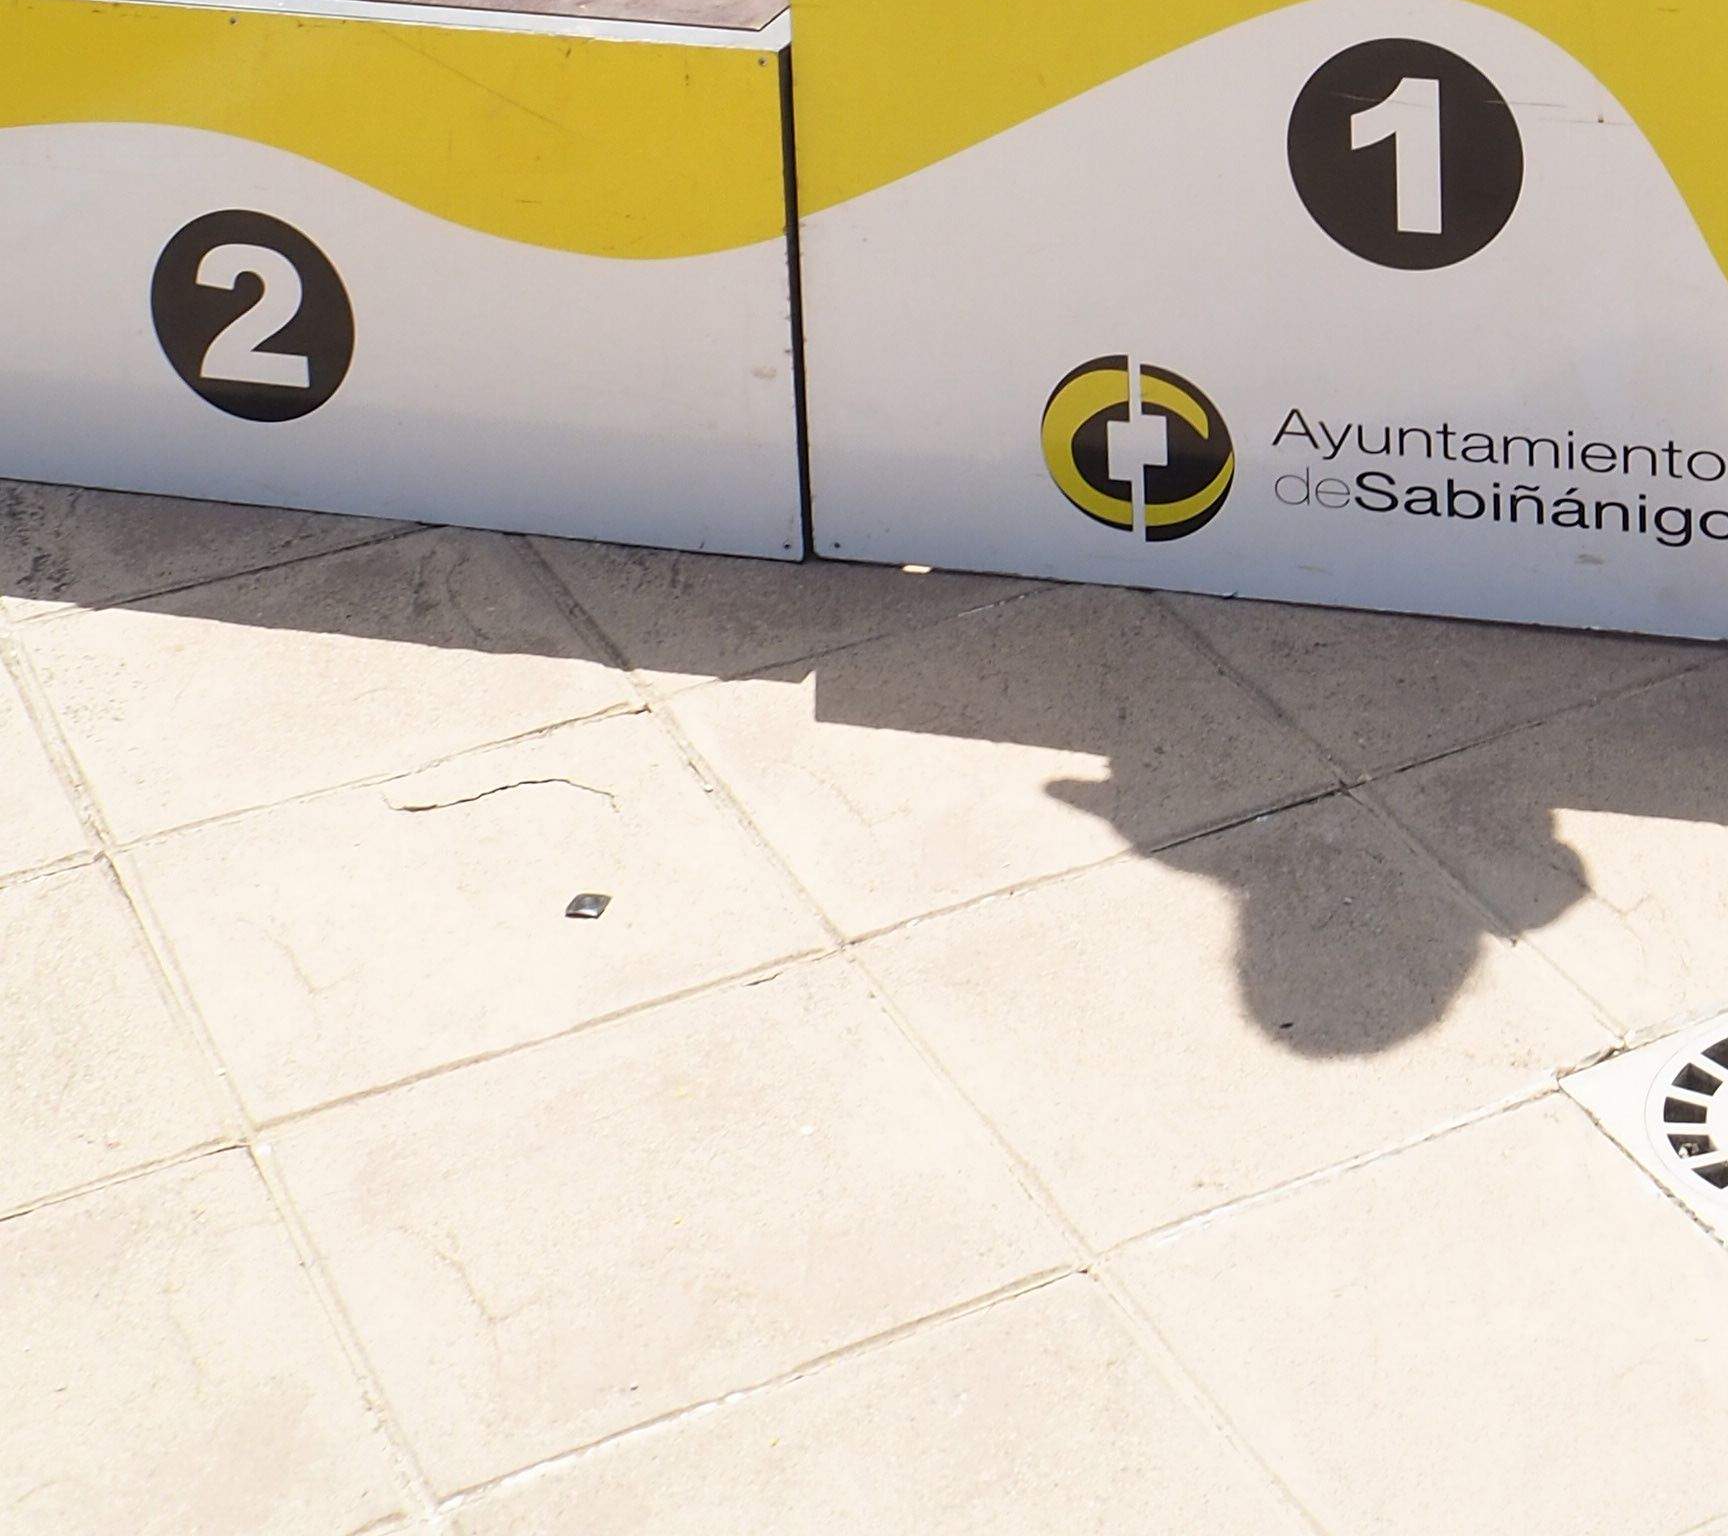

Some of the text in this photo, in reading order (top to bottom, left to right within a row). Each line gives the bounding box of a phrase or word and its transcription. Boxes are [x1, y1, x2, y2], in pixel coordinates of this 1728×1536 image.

[1350, 76, 1442, 234] 1
[195, 242, 311, 389] 2
[1272, 407, 1728, 483] Ayuntamiento
